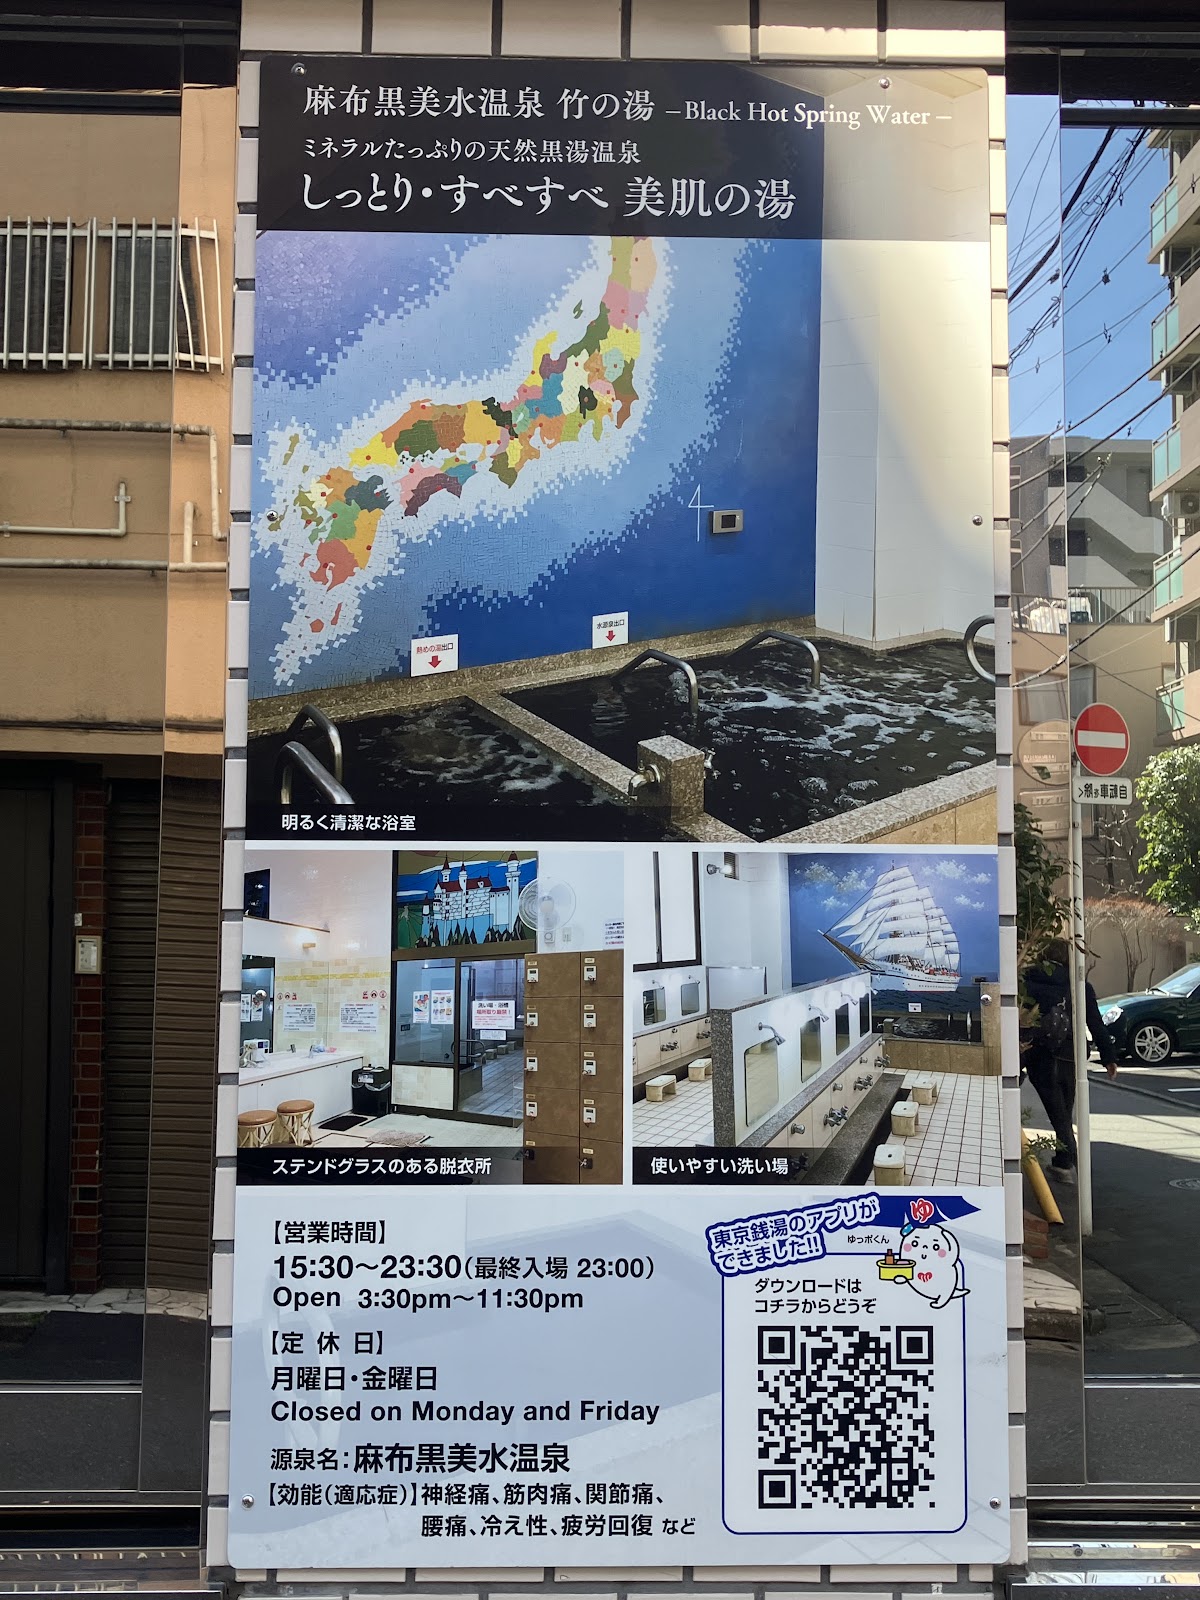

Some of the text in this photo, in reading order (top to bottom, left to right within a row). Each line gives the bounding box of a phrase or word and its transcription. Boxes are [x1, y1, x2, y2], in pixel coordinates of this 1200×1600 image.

[303, 85, 544, 119] 麻布黒美水温泉
[557, 88, 656, 121] 竹の湯
[747, 102, 788, 122] Hot
[793, 102, 861, 130] Spring
[303, 137, 641, 165] ミネラルたっぷりの天然黒湯温泉
[303, 173, 797, 220] しっとり・すべすべ 美肌の湯
[281, 814, 417, 831] 明るく清潔な浴室
[272, 1157, 492, 1175] ステンドグラスのある脱衣所
[650, 1156, 789, 1175] 使いやすい洗い場
[910, 1198, 934, 1221] ゆ
[274, 1220, 386, 1245] 【営業時間】
[712, 1199, 878, 1249] 東京銭湯のアプリが
[847, 1234, 890, 1244] ゆっポくん
[754, 1277, 862, 1294] ダウンロードは
[272, 1287, 341, 1308] Open
[754, 1297, 877, 1314] コチラからどうぞ
[270, 1365, 437, 1392] 月曜日・金曜日
[270, 1401, 660, 1425] Closed on Monday and Friday
[421, 1513, 696, 1538] 腰痛、冷え性、疲労回復 など
